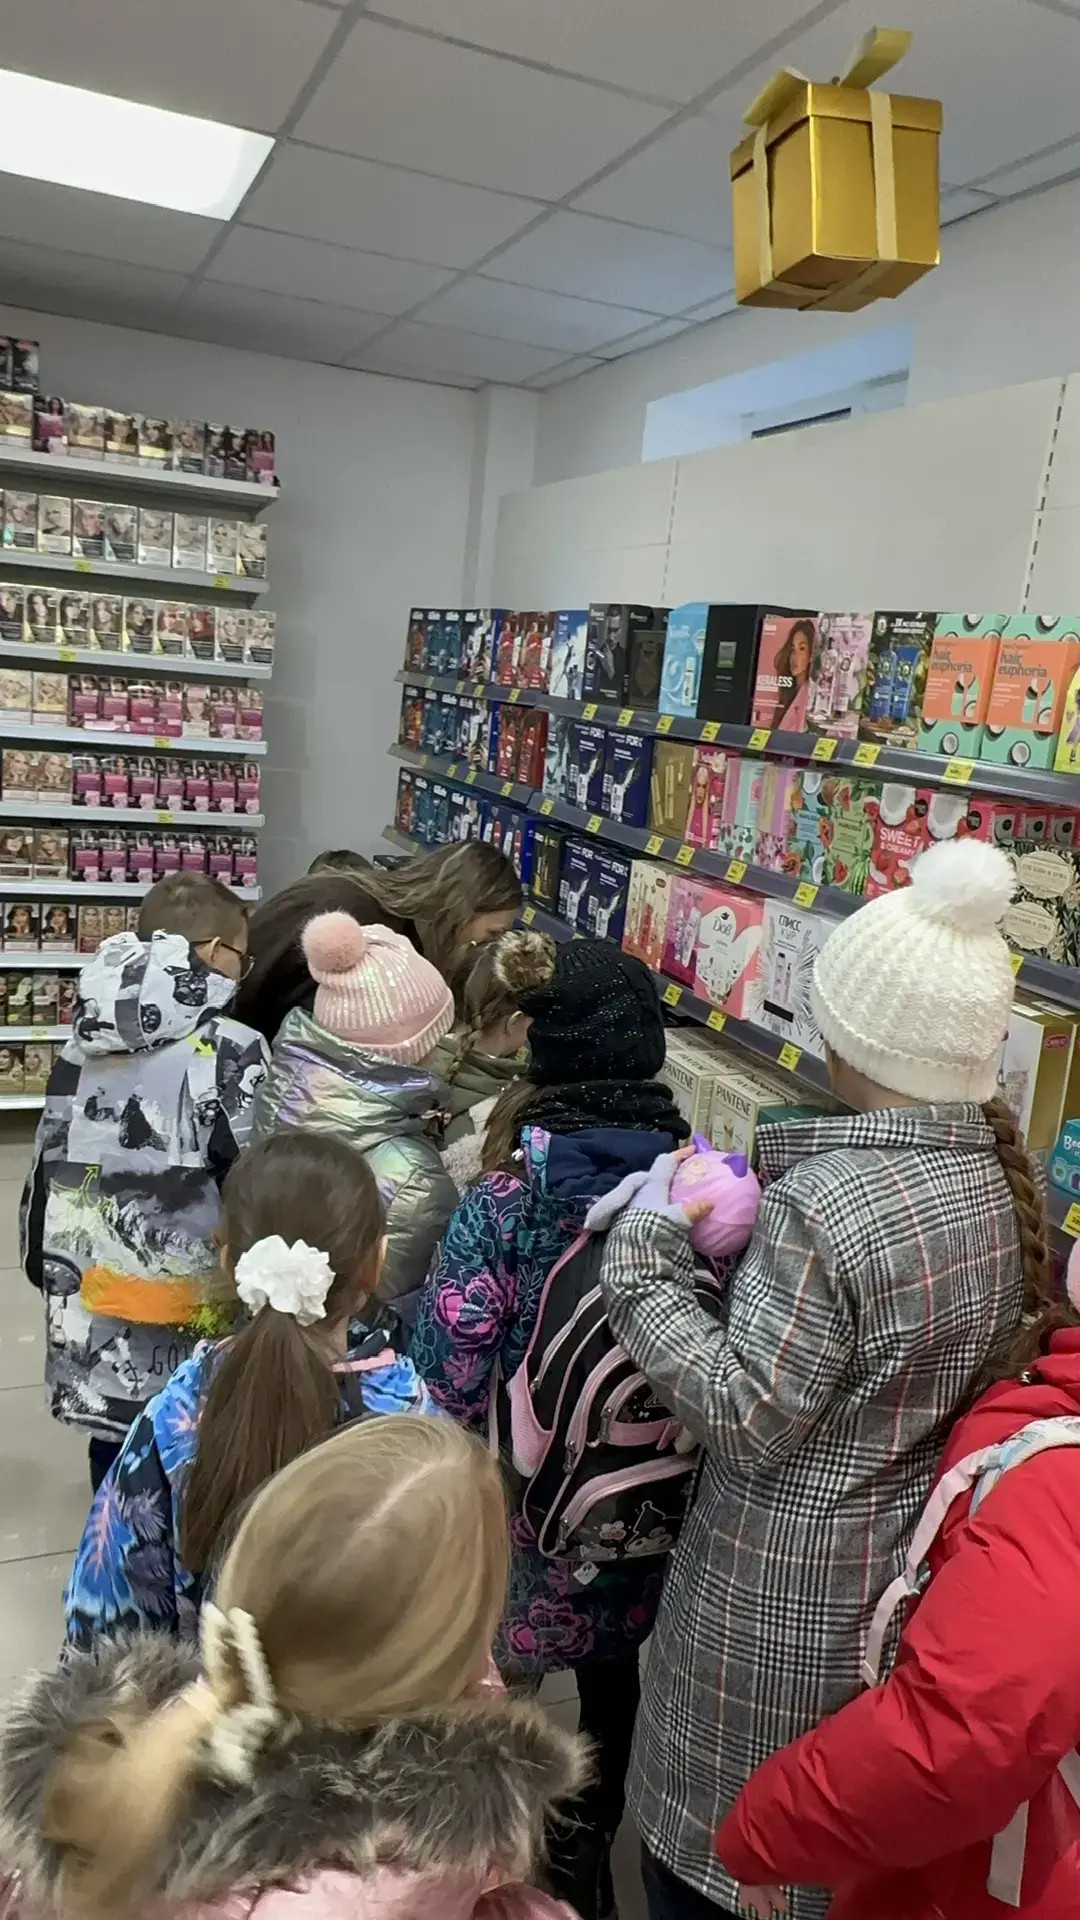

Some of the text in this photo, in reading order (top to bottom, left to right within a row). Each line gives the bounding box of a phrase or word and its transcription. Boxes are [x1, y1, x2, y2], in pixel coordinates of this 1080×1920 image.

[998, 664, 1047, 678] euphoria
[879, 827, 921, 848] SWEET
[716, 1084, 752, 1117] PANTENE
